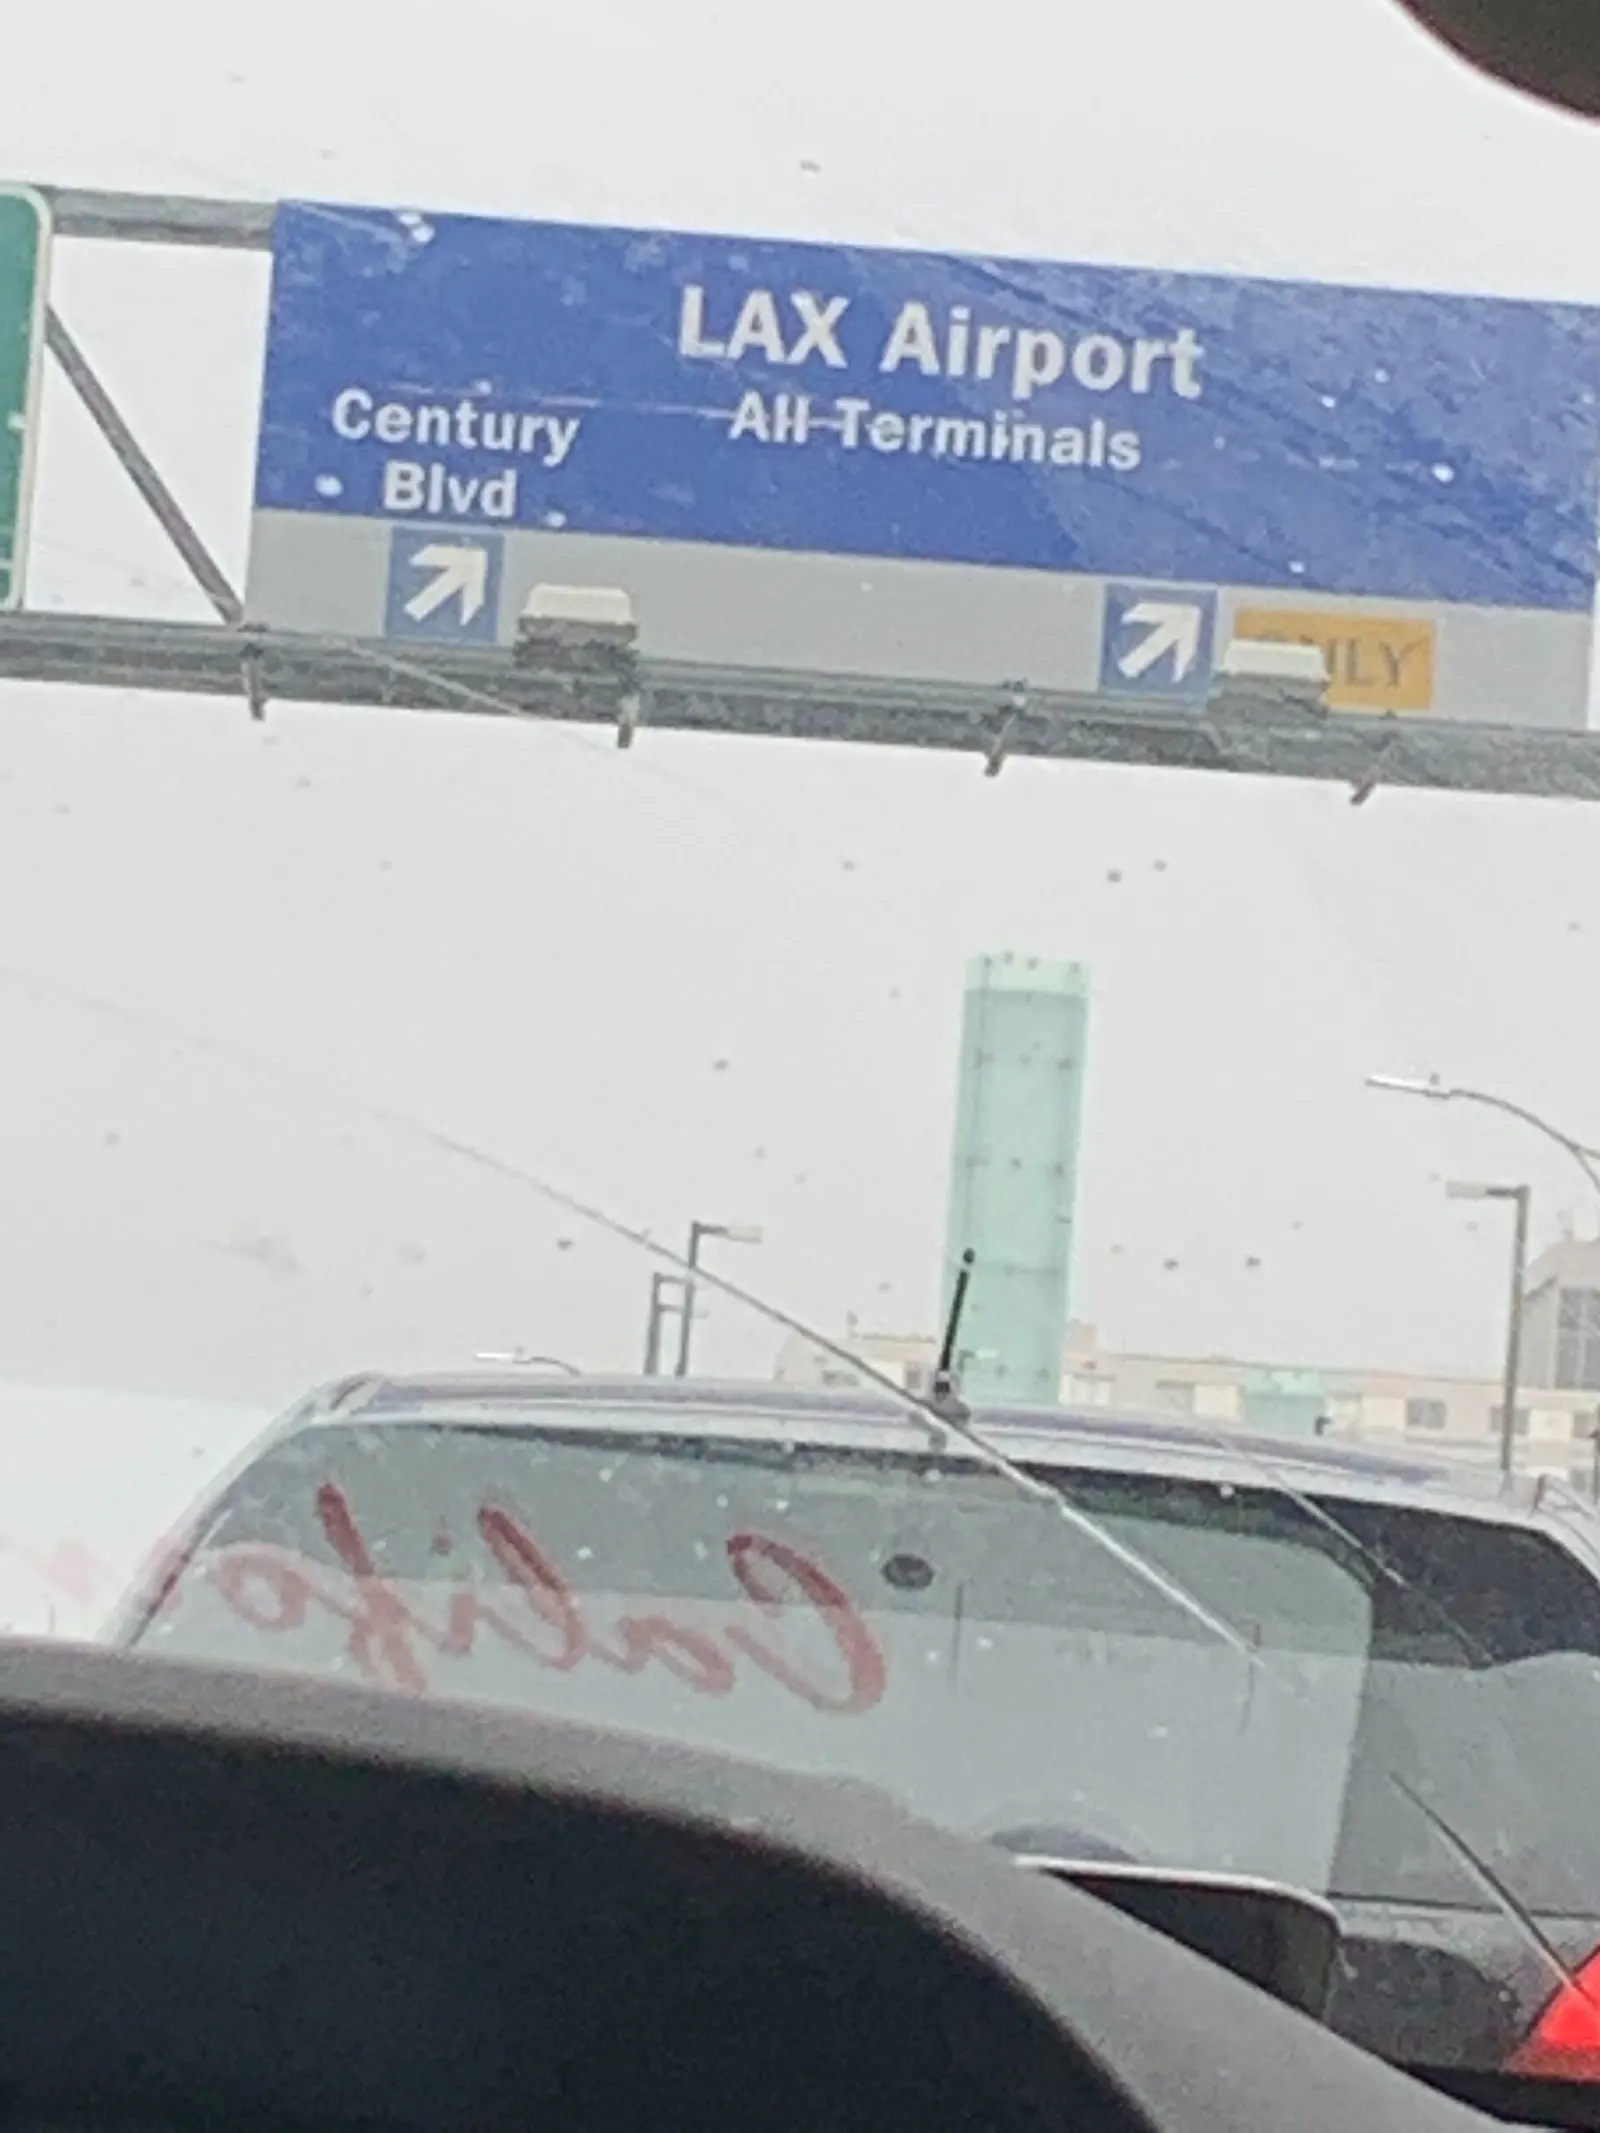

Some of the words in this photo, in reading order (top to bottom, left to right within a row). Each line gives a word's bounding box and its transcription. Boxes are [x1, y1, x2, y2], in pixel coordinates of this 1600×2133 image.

[678, 285, 849, 369] LAX
[878, 301, 1206, 400] Airport
[331, 387, 581, 467] Century
[728, 391, 811, 444] All
[834, 398, 1142, 471] Terminals
[383, 458, 518, 519] Blvd
[1255, 631, 1430, 688] LY
